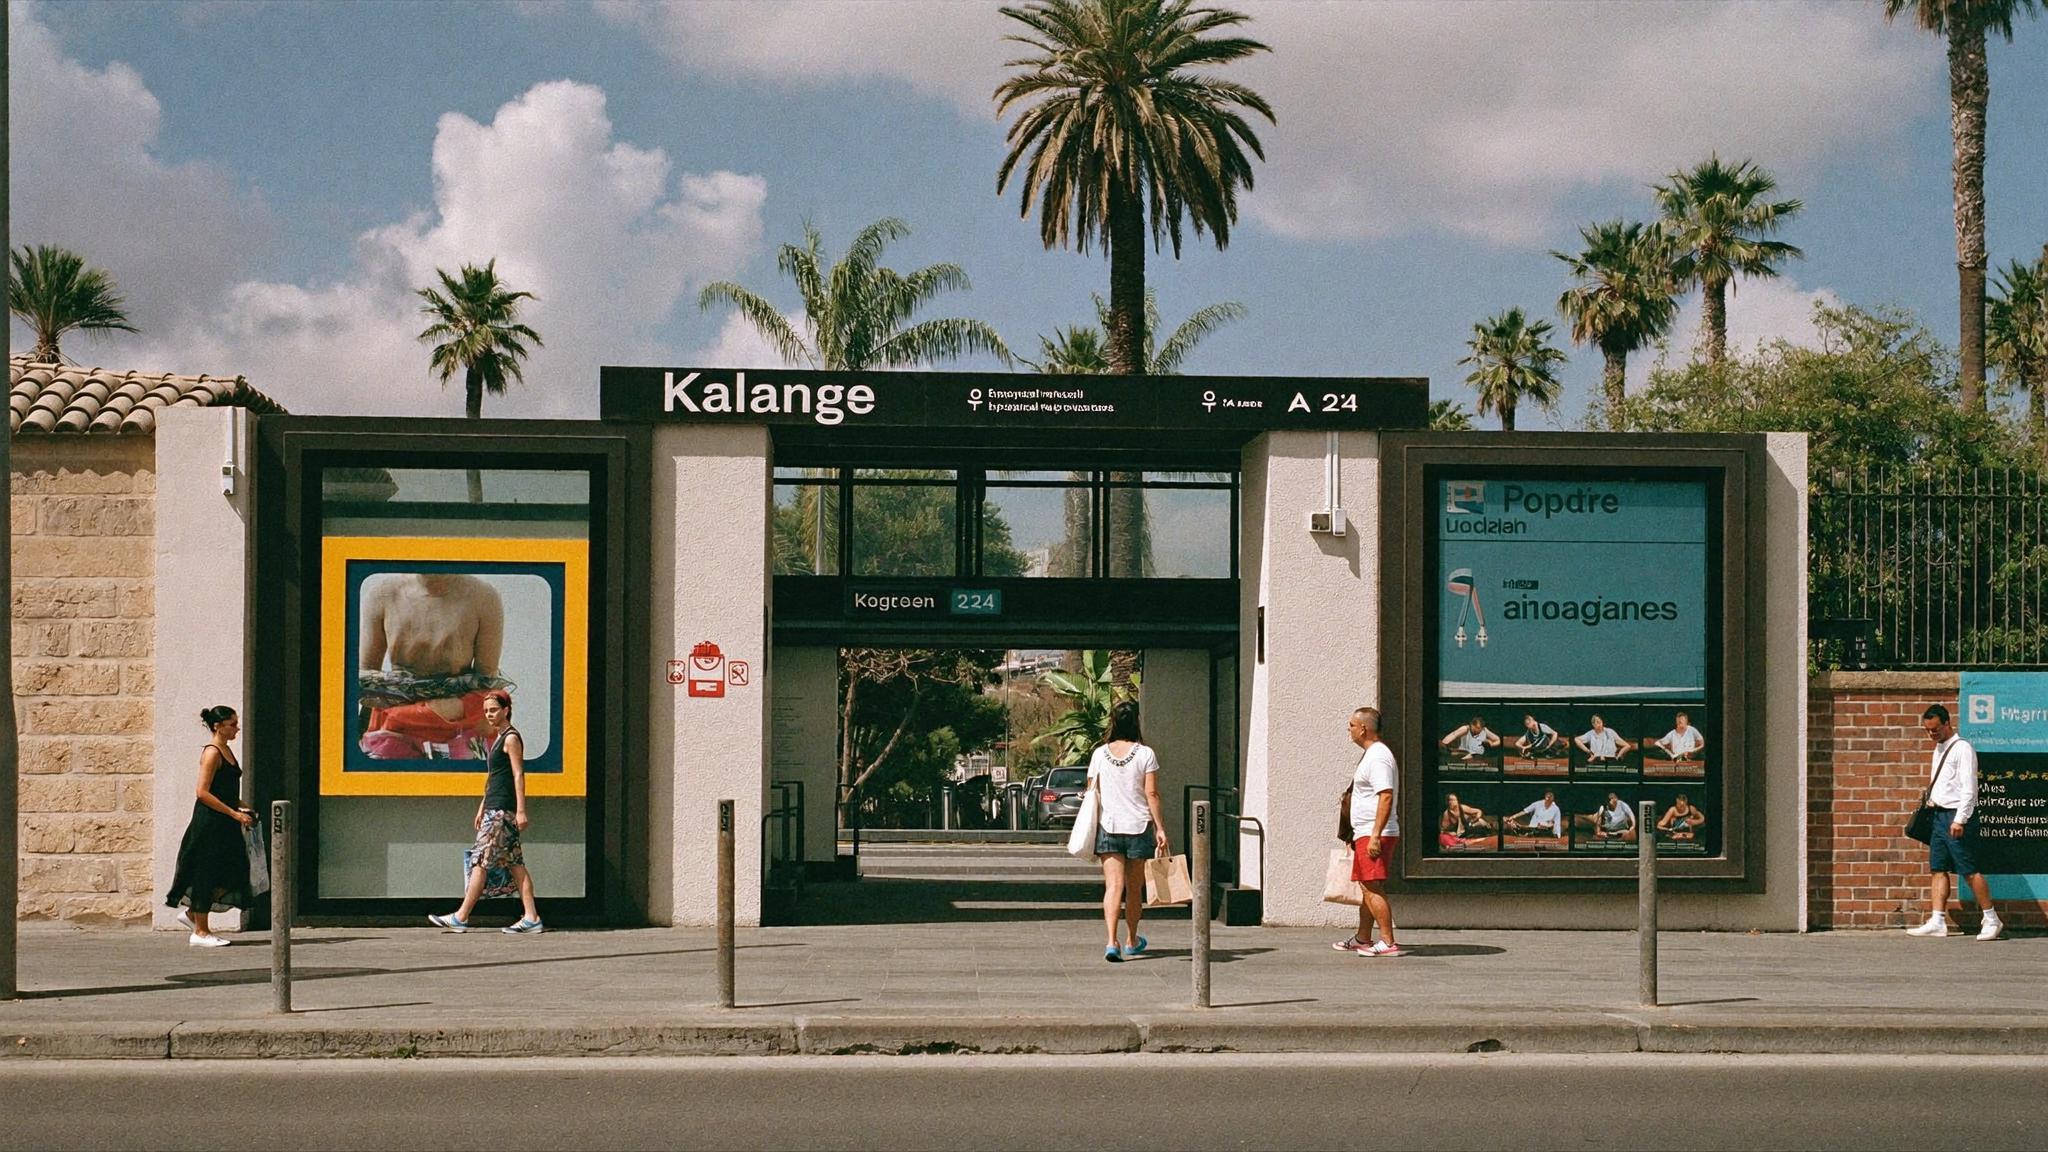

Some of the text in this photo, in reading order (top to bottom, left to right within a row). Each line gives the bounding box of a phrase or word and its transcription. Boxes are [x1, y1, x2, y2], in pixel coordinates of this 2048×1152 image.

[664, 372, 875, 425] Kalange
[1287, 392, 1311, 413] A
[957, 594, 995, 609] 224
